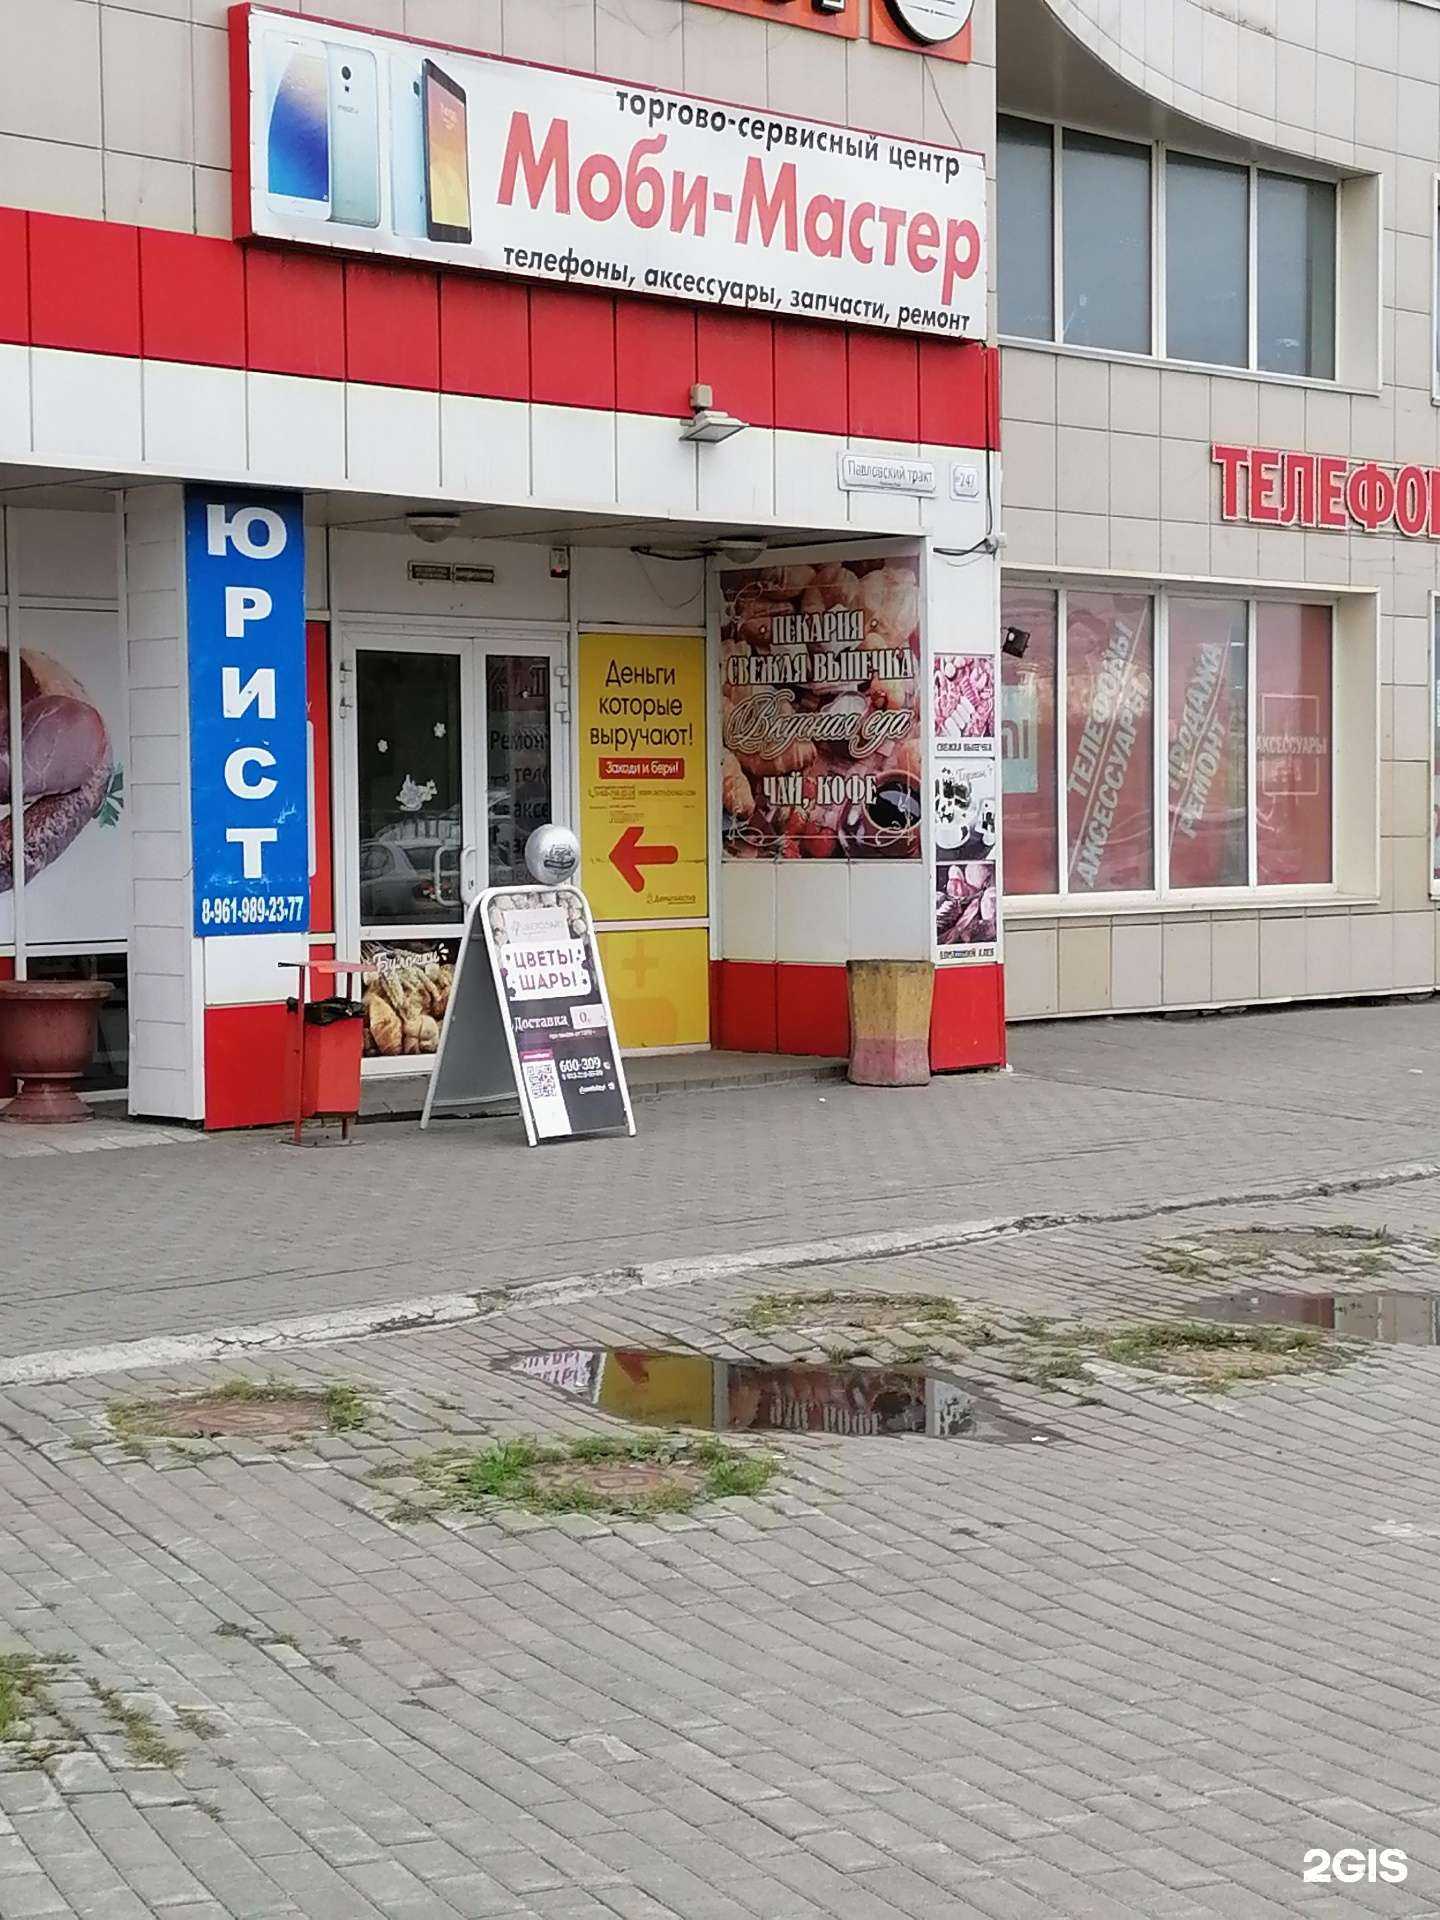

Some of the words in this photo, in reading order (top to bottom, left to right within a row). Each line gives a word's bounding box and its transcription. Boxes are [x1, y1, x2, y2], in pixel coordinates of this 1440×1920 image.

[617, 91, 879, 161] торгово-сервисный
[888, 143, 960, 183] центр
[497, 110, 981, 305] Моби-Мастер
[503, 247, 637, 286] телефоны,
[645, 267, 782, 308] аксессуары,
[790, 289, 890, 325] запчасти,
[898, 302, 969, 332] ремонт
[848, 460, 905, 479] Павловский
[907, 469, 932, 484] тракт
[771, 609, 865, 645] ПЕКАРНЯ
[605, 659, 676, 687] Деньги
[726, 653, 808, 686] СВЕЖАЯ
[816, 647, 915, 683] ВЫПЕЧКА
[207, 504, 288, 879] ЮРИСТ
[598, 697, 683, 721] которые
[489, 730, 547, 750] Ремон
[590, 723, 693, 752] выручают!
[850, 709, 915, 760] еда
[763, 772, 810, 808] ЧАЙ,
[817, 774, 878, 806] КОФЕ
[202, 896, 304, 925] 8-961-989-23-77
[513, 948, 573, 969] ЦВЕТЫ
[519, 971, 577, 990] ШАРЫ
[514, 1015, 569, 1031] Доставка
